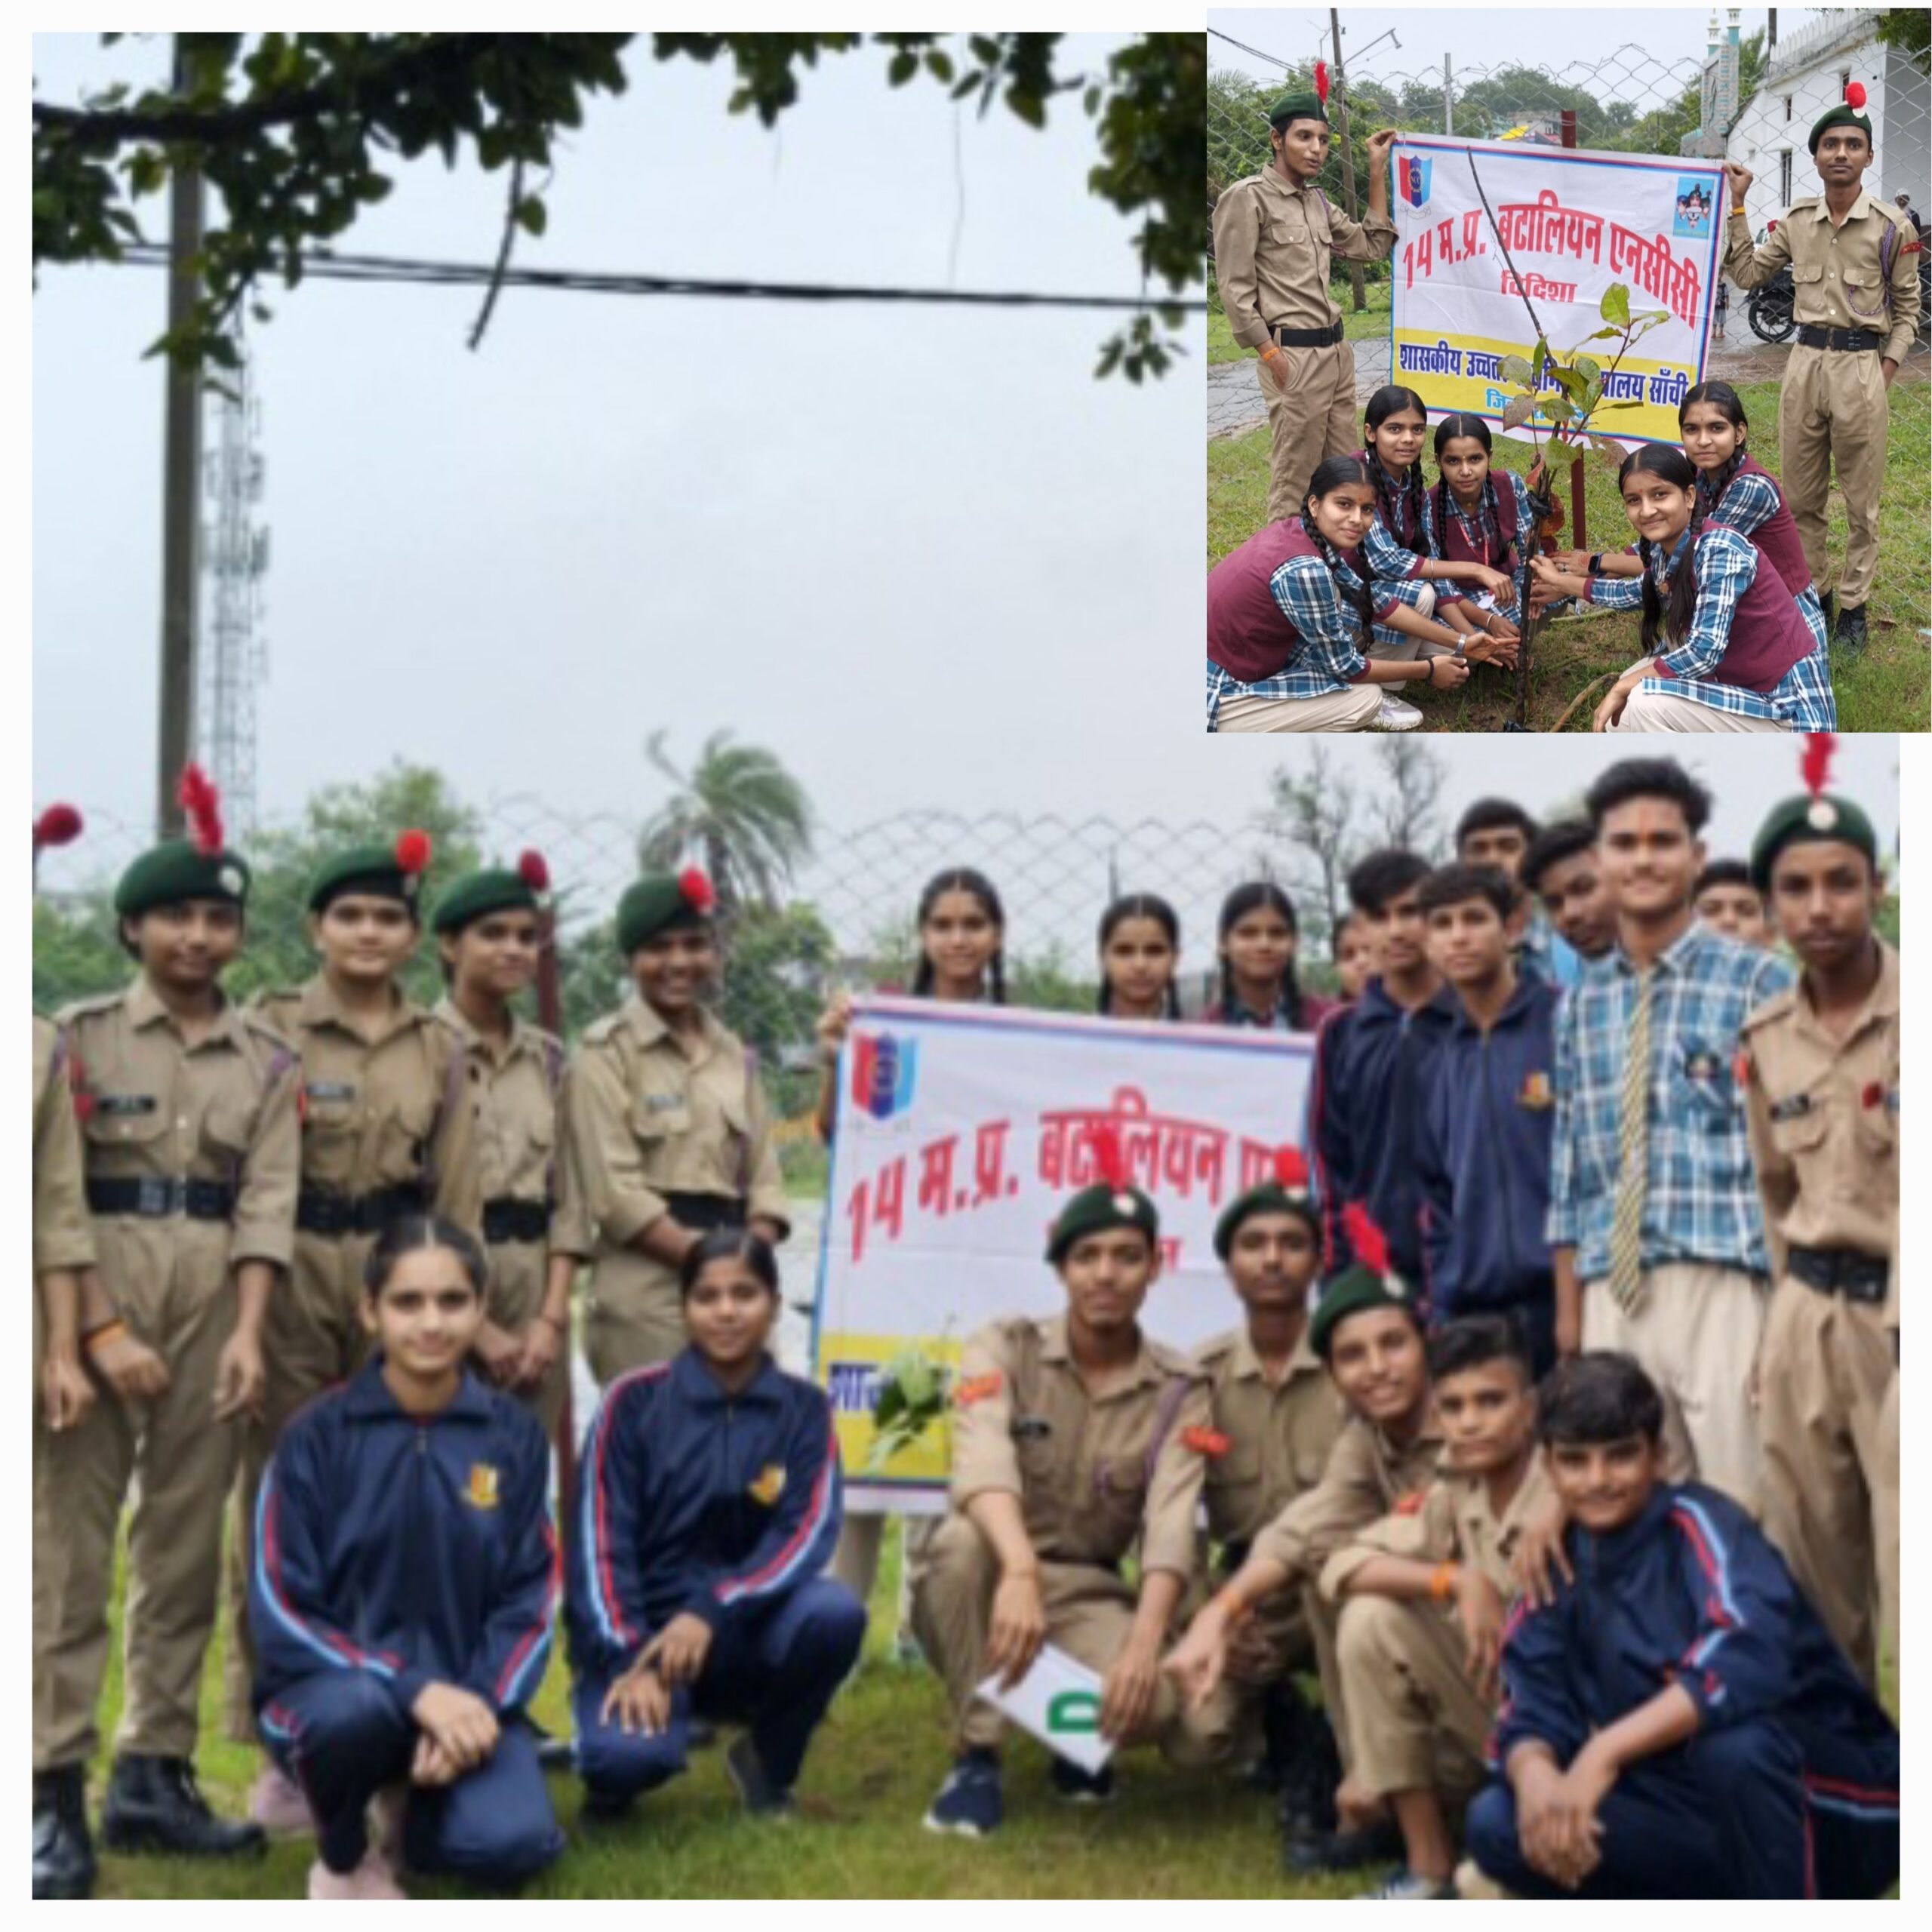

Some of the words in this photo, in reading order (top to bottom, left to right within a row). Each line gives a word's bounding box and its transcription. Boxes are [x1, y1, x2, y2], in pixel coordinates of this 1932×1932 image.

[1402, 228, 1432, 291] 14
[1437, 208, 1486, 266] म.प्र.
[1497, 189, 1605, 265] बटालियन
[1609, 221, 1702, 331] एनसीसी
[1500, 269, 1578, 303] विदिशा
[1399, 340, 1463, 376] शासकीय
[1466, 351, 1509, 383] उच्चत
[1649, 368, 1689, 406] साँची
[845, 1153, 906, 1263] 14
[918, 1117, 1019, 1217] म.प्र.
